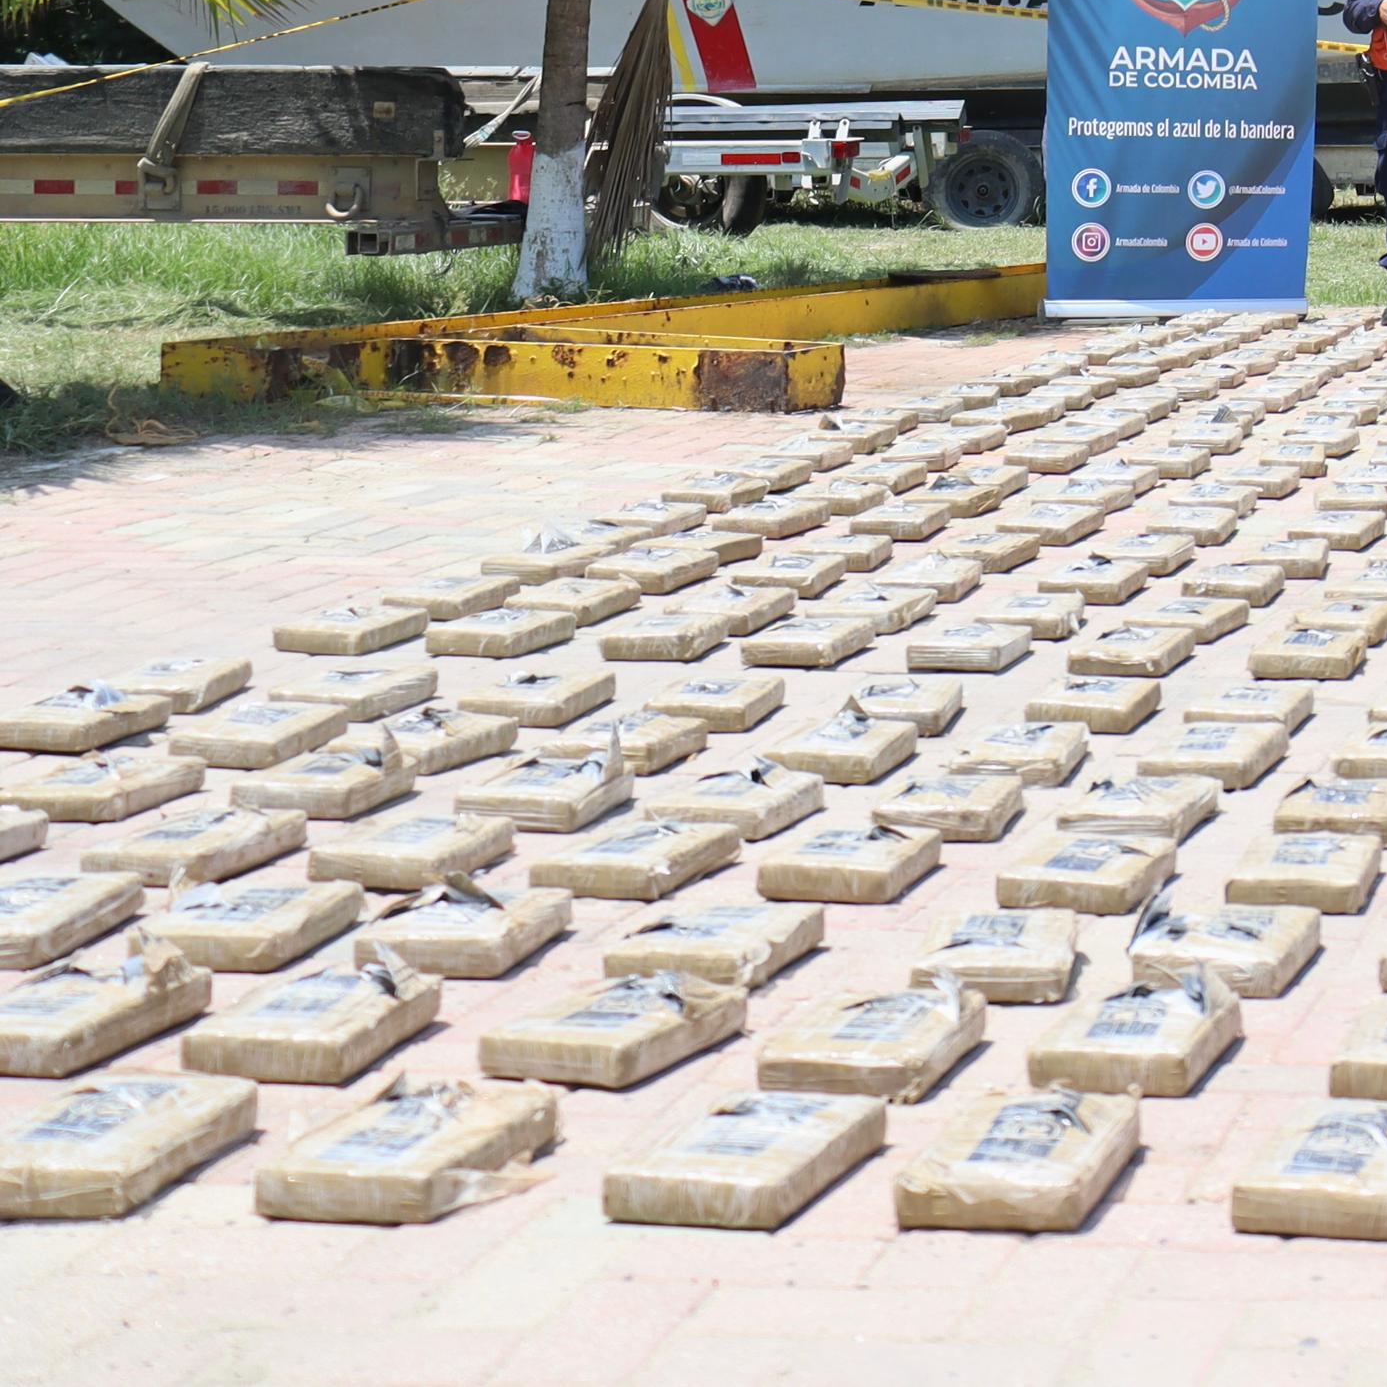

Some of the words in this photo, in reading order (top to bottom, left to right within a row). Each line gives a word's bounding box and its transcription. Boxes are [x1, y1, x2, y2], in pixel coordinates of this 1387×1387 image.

[1109, 46, 1258, 73] ARMADA
[1109, 72, 1138, 87] DE
[1144, 73, 1258, 90] COLOMBIA
[1068, 117, 1153, 140] Protegemos
[1157, 118, 1169, 137] el
[1173, 119, 1201, 138] azul
[1205, 120, 1221, 138] de
[1225, 120, 1237, 138] la
[1240, 120, 1295, 140] bandera
[1116, 184, 1141, 193] Armada
[1142, 184, 1150, 193] de
[1151, 184, 1180, 194] Colombia
